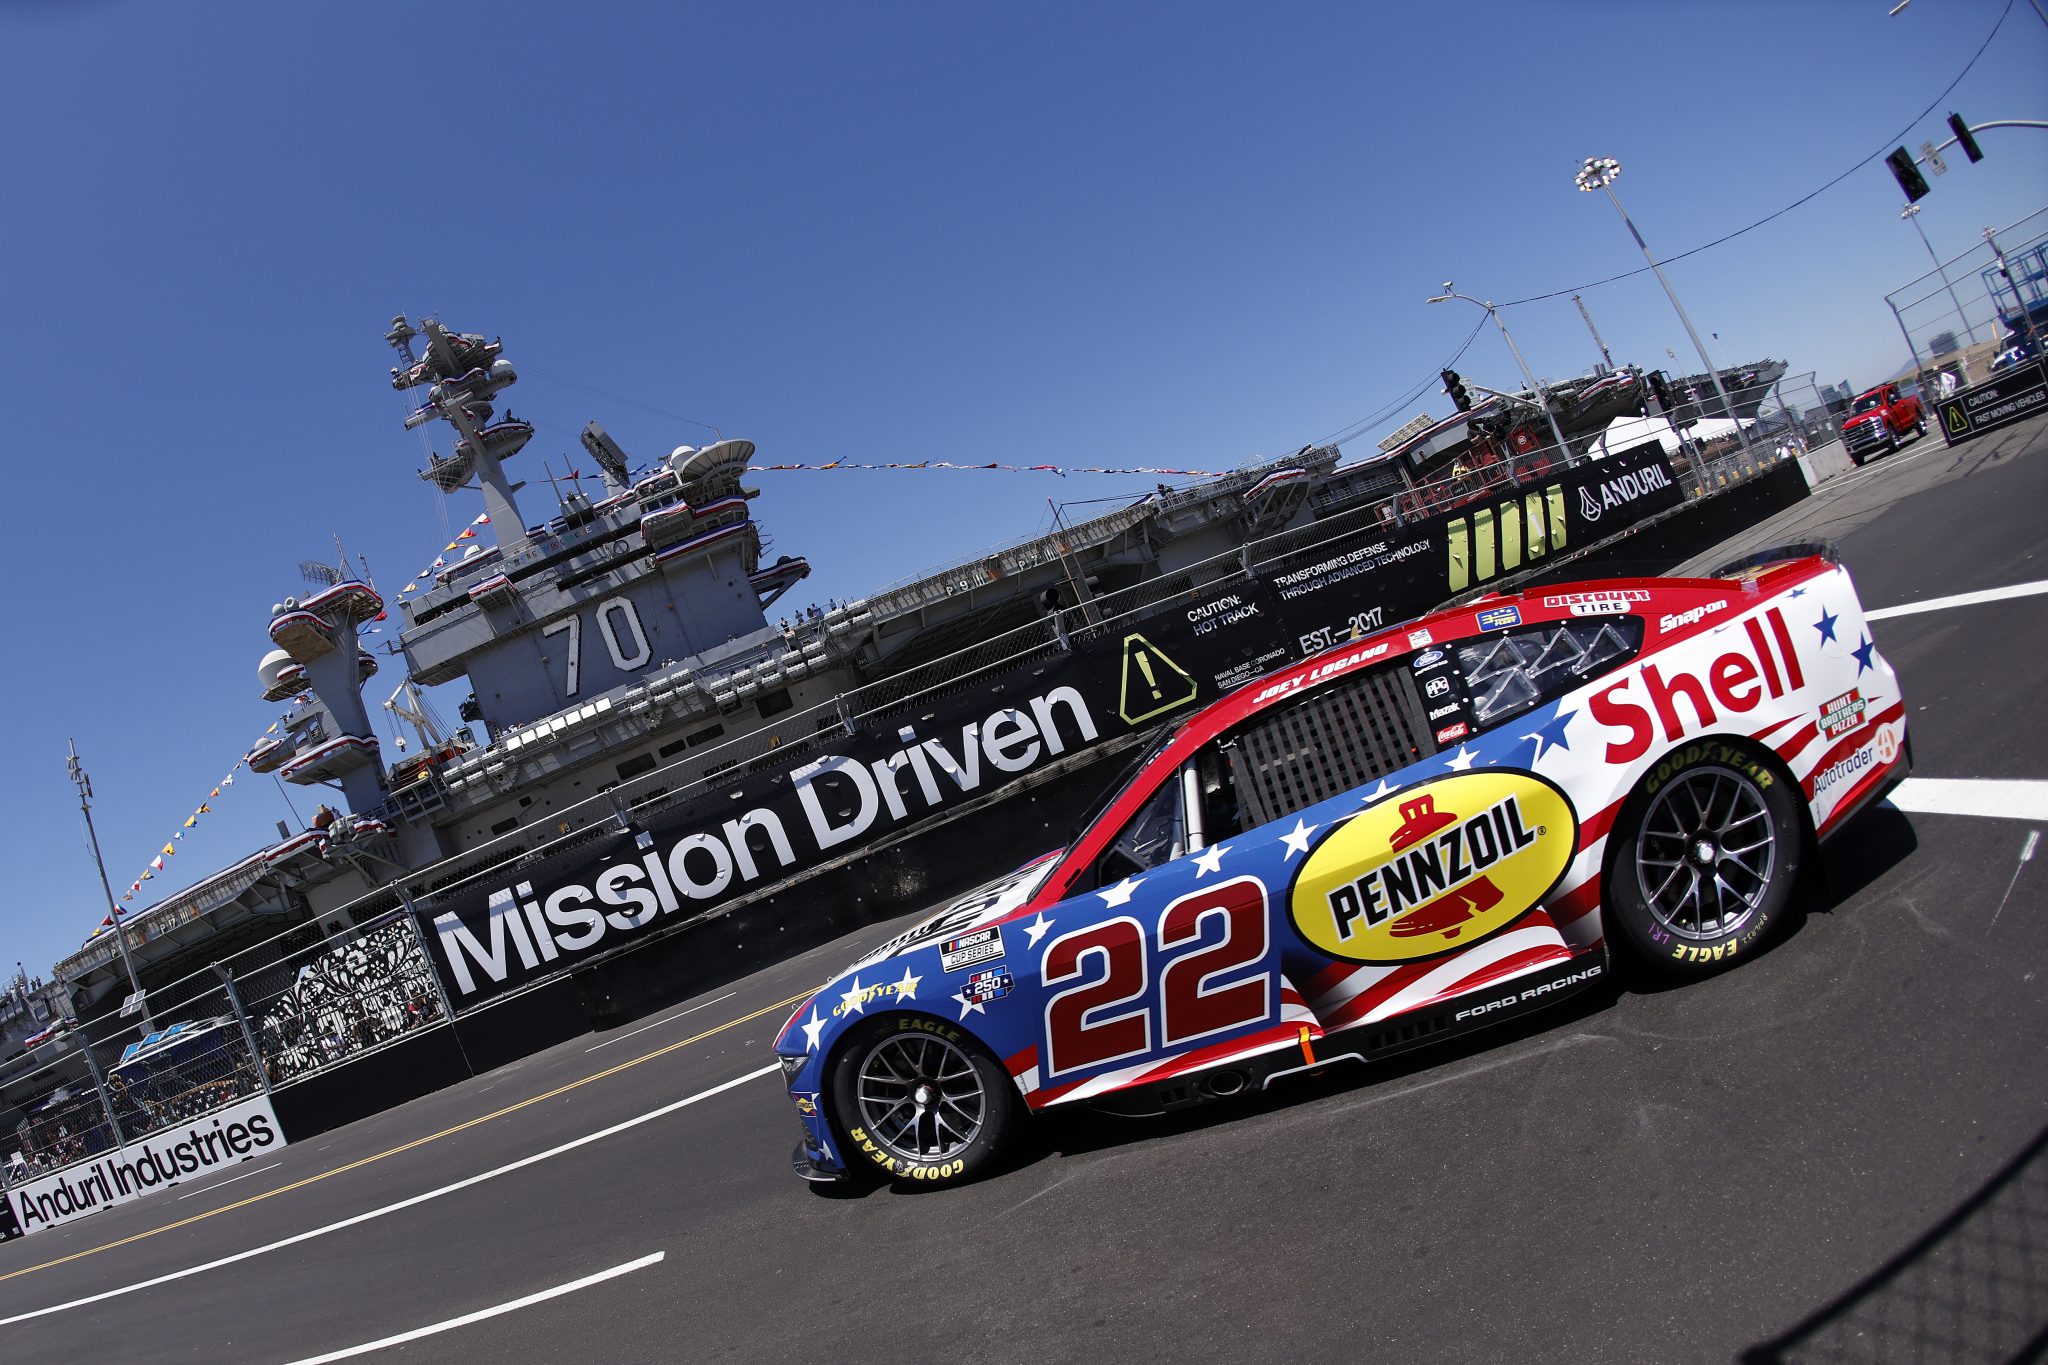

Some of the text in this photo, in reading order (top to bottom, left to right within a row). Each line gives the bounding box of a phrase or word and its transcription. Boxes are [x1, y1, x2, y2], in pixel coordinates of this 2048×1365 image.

[1968, 389, 1999, 407] CAUTION:
[1975, 390, 2046, 425] FAST MOVING VEHICLES
[1601, 463, 1672, 511] ANDURIL
[1273, 541, 1388, 589] TRANSFORMING DEFENSE
[1279, 538, 1432, 601] THROUGH ADVANCED TECHNOLOGY
[1187, 595, 1242, 622] CAUTION:
[1545, 591, 1650, 607] DISCOUNT
[1576, 601, 1624, 614] TIRE
[1659, 599, 1728, 634] Snap-on
[1193, 602, 1260, 637] HOT TRACK
[542, 596, 654, 697] 70
[1214, 647, 1286, 682] NAVAL BASE CORONADO
[1253, 643, 1390, 704] JOEY LOGANO
[1217, 679, 1232, 689] SAN
[1426, 679, 1448, 696] PPG
[1588, 606, 1806, 764] Shell
[1429, 702, 1461, 721] Mazak
[1821, 700, 1865, 729] BROTHERS
[1826, 693, 1852, 714] HUNT
[1831, 715, 1859, 736] PIZZA
[1646, 740, 1776, 794] GOODYEAR
[1814, 747, 1874, 797] Autotrader
[432, 685, 1099, 995] Mission Driven
[1327, 795, 1538, 943] PENNZOIL
[951, 944, 994, 964] CUP SERIES
[958, 930, 992, 949] NASCAR
[1672, 937, 1739, 963] EAGLE
[974, 977, 1001, 995] 250
[1041, 875, 1270, 1079] 22
[1455, 965, 1603, 1022] FORD RACING
[832, 981, 919, 1017] GOODYEAR
[898, 1018, 961, 1043] EAGLE
[850, 1126, 964, 1180] GOODYEAR
[19, 1164, 114, 1229] Anduril
[106, 1114, 275, 1198] Industries
